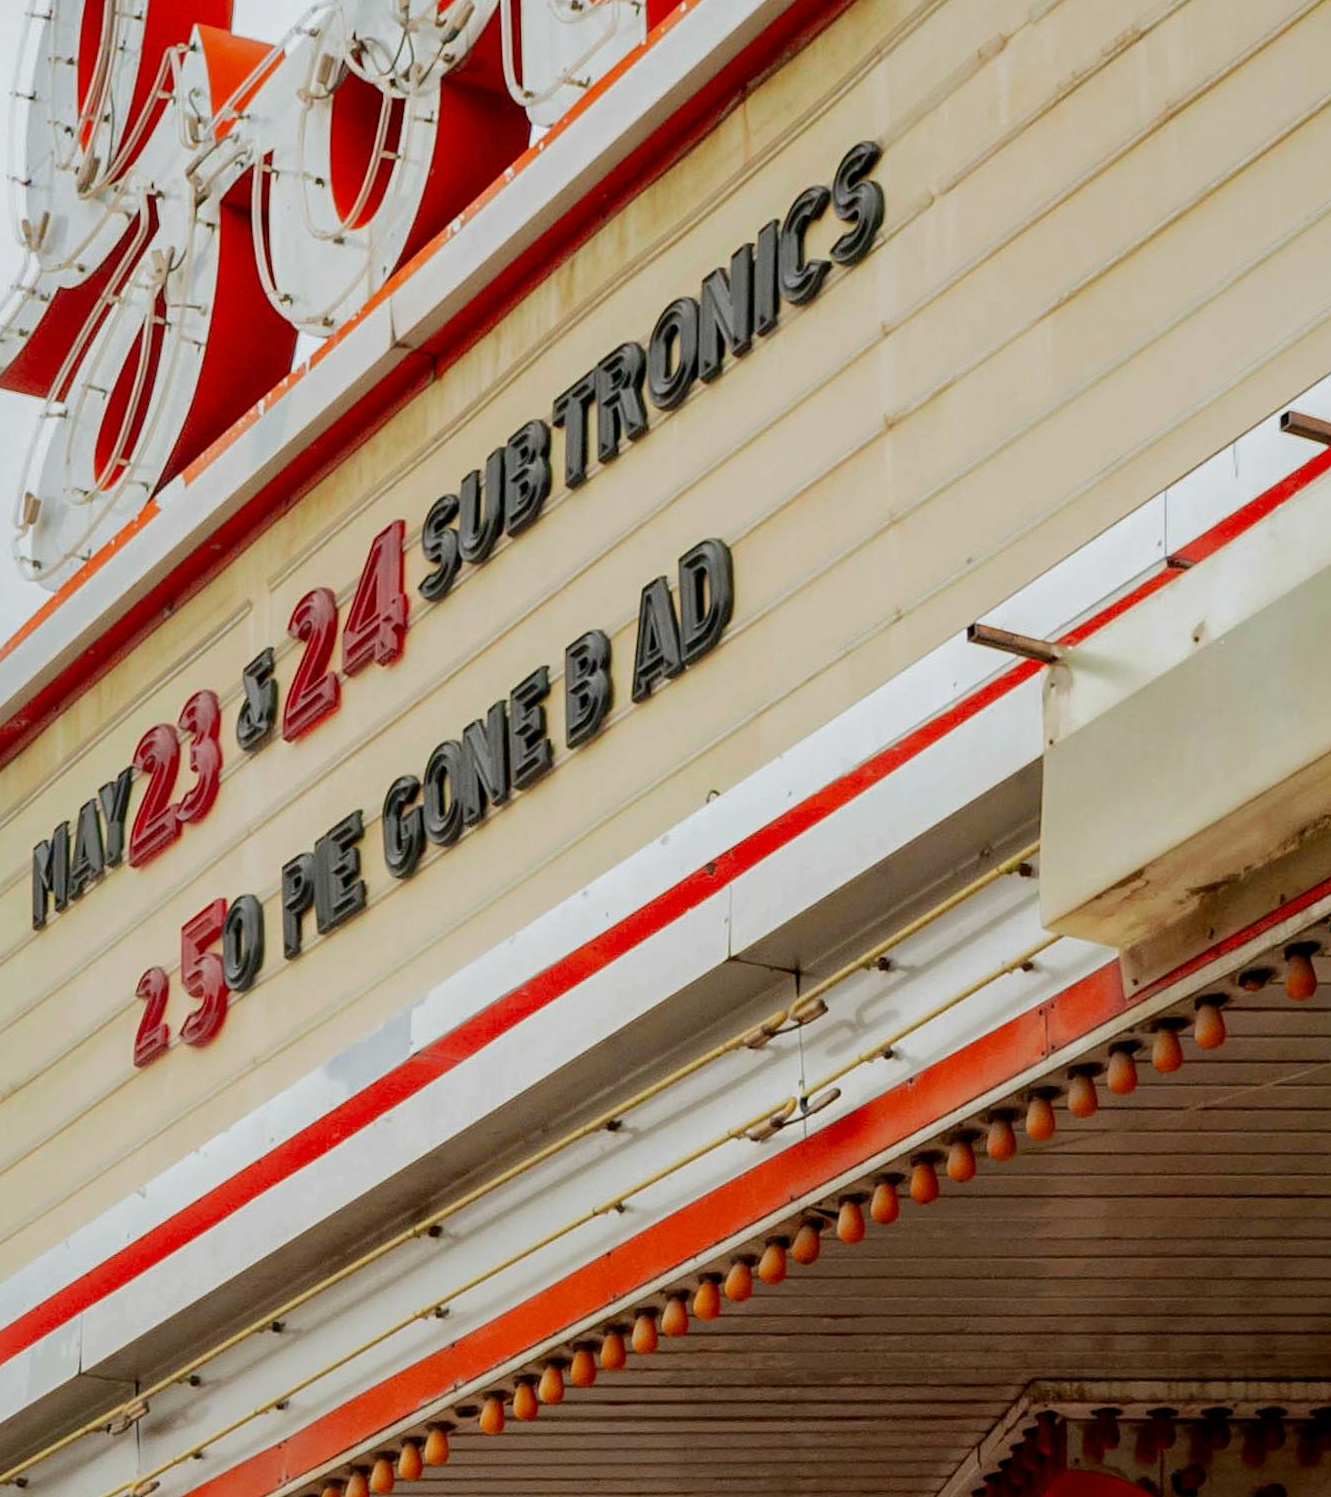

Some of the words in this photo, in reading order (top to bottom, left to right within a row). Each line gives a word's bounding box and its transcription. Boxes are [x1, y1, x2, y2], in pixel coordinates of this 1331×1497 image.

[281, 518, 410, 743] 24
[419, 139, 888, 604] SUBTRONICS
[280, 808, 368, 960] PIE
[381, 664, 554, 881] GONE
